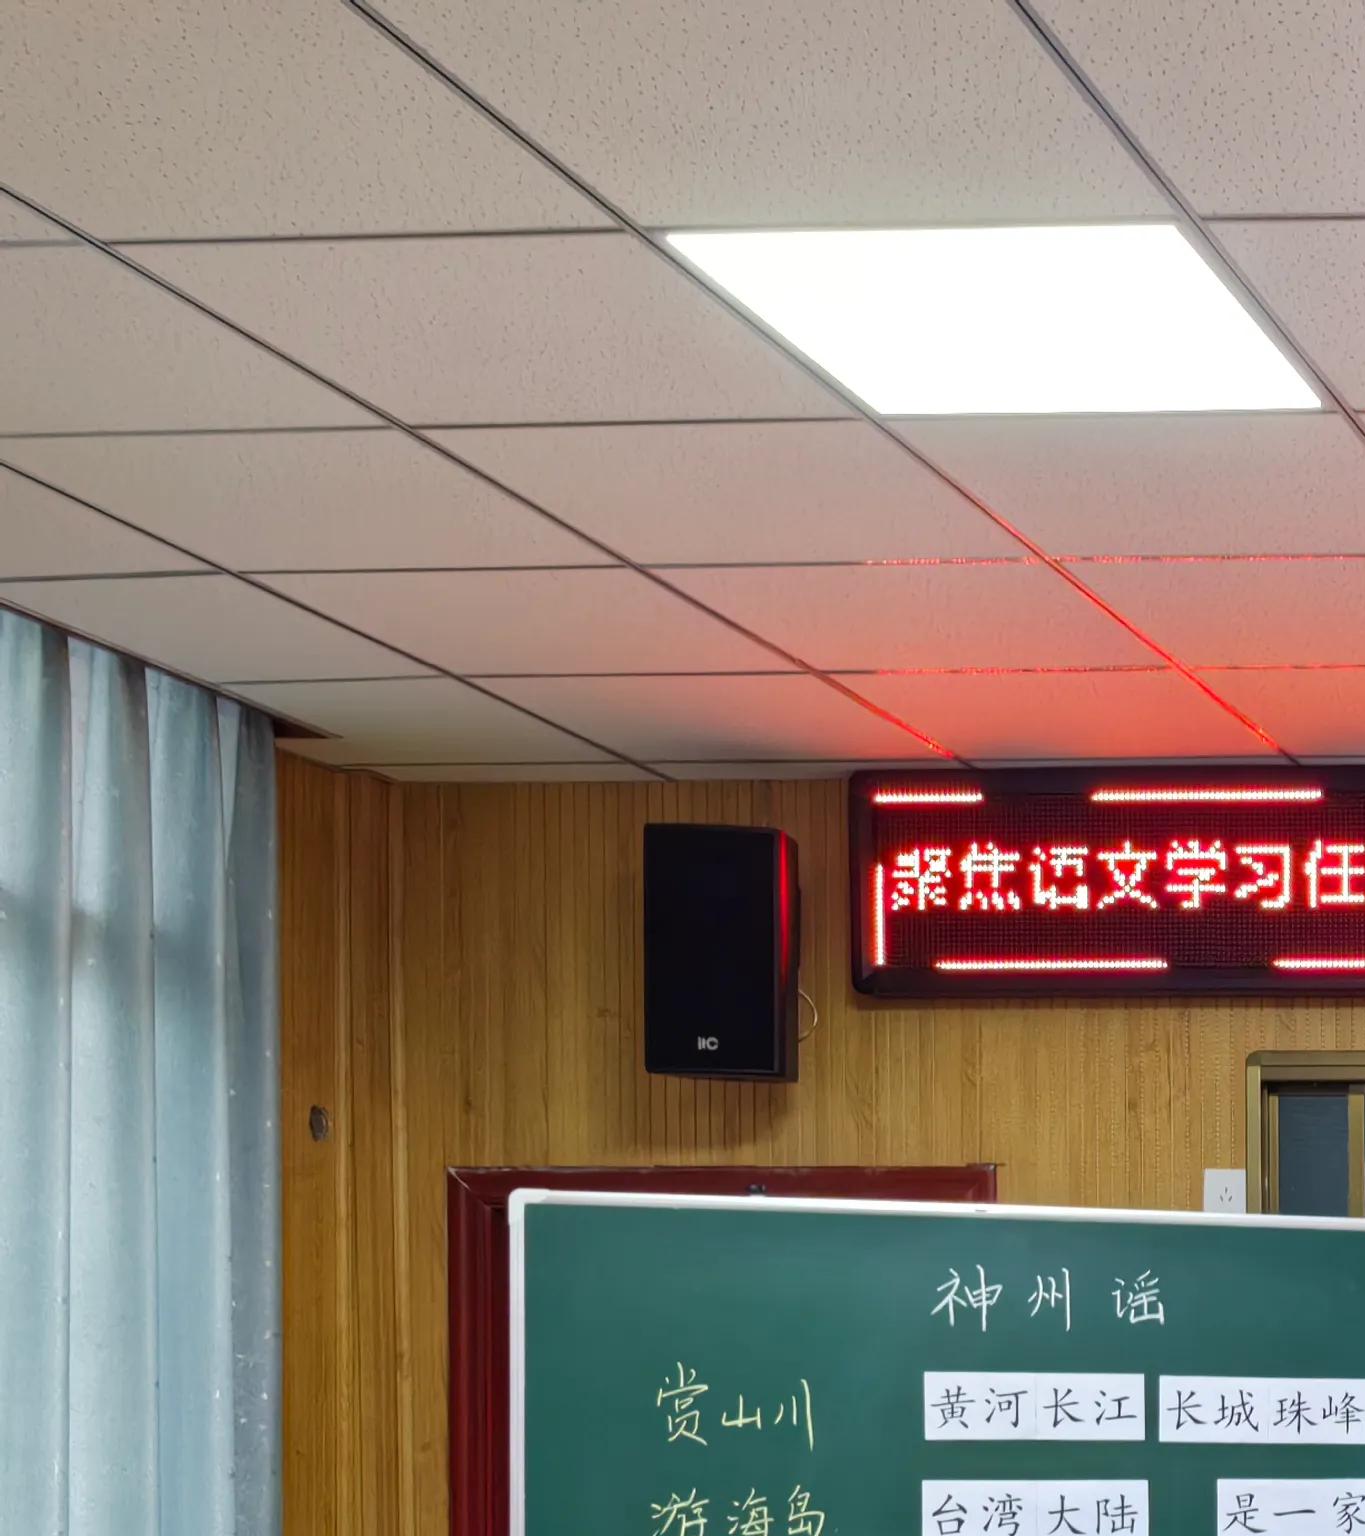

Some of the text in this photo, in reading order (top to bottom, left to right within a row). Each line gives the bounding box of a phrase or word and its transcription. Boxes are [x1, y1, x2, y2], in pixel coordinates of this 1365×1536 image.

[930, 1264, 1166, 1332] 神州谣
[656, 1361, 815, 1451] 赏山川
[930, 1385, 1365, 1435] 黄河长江 长城珠峰
